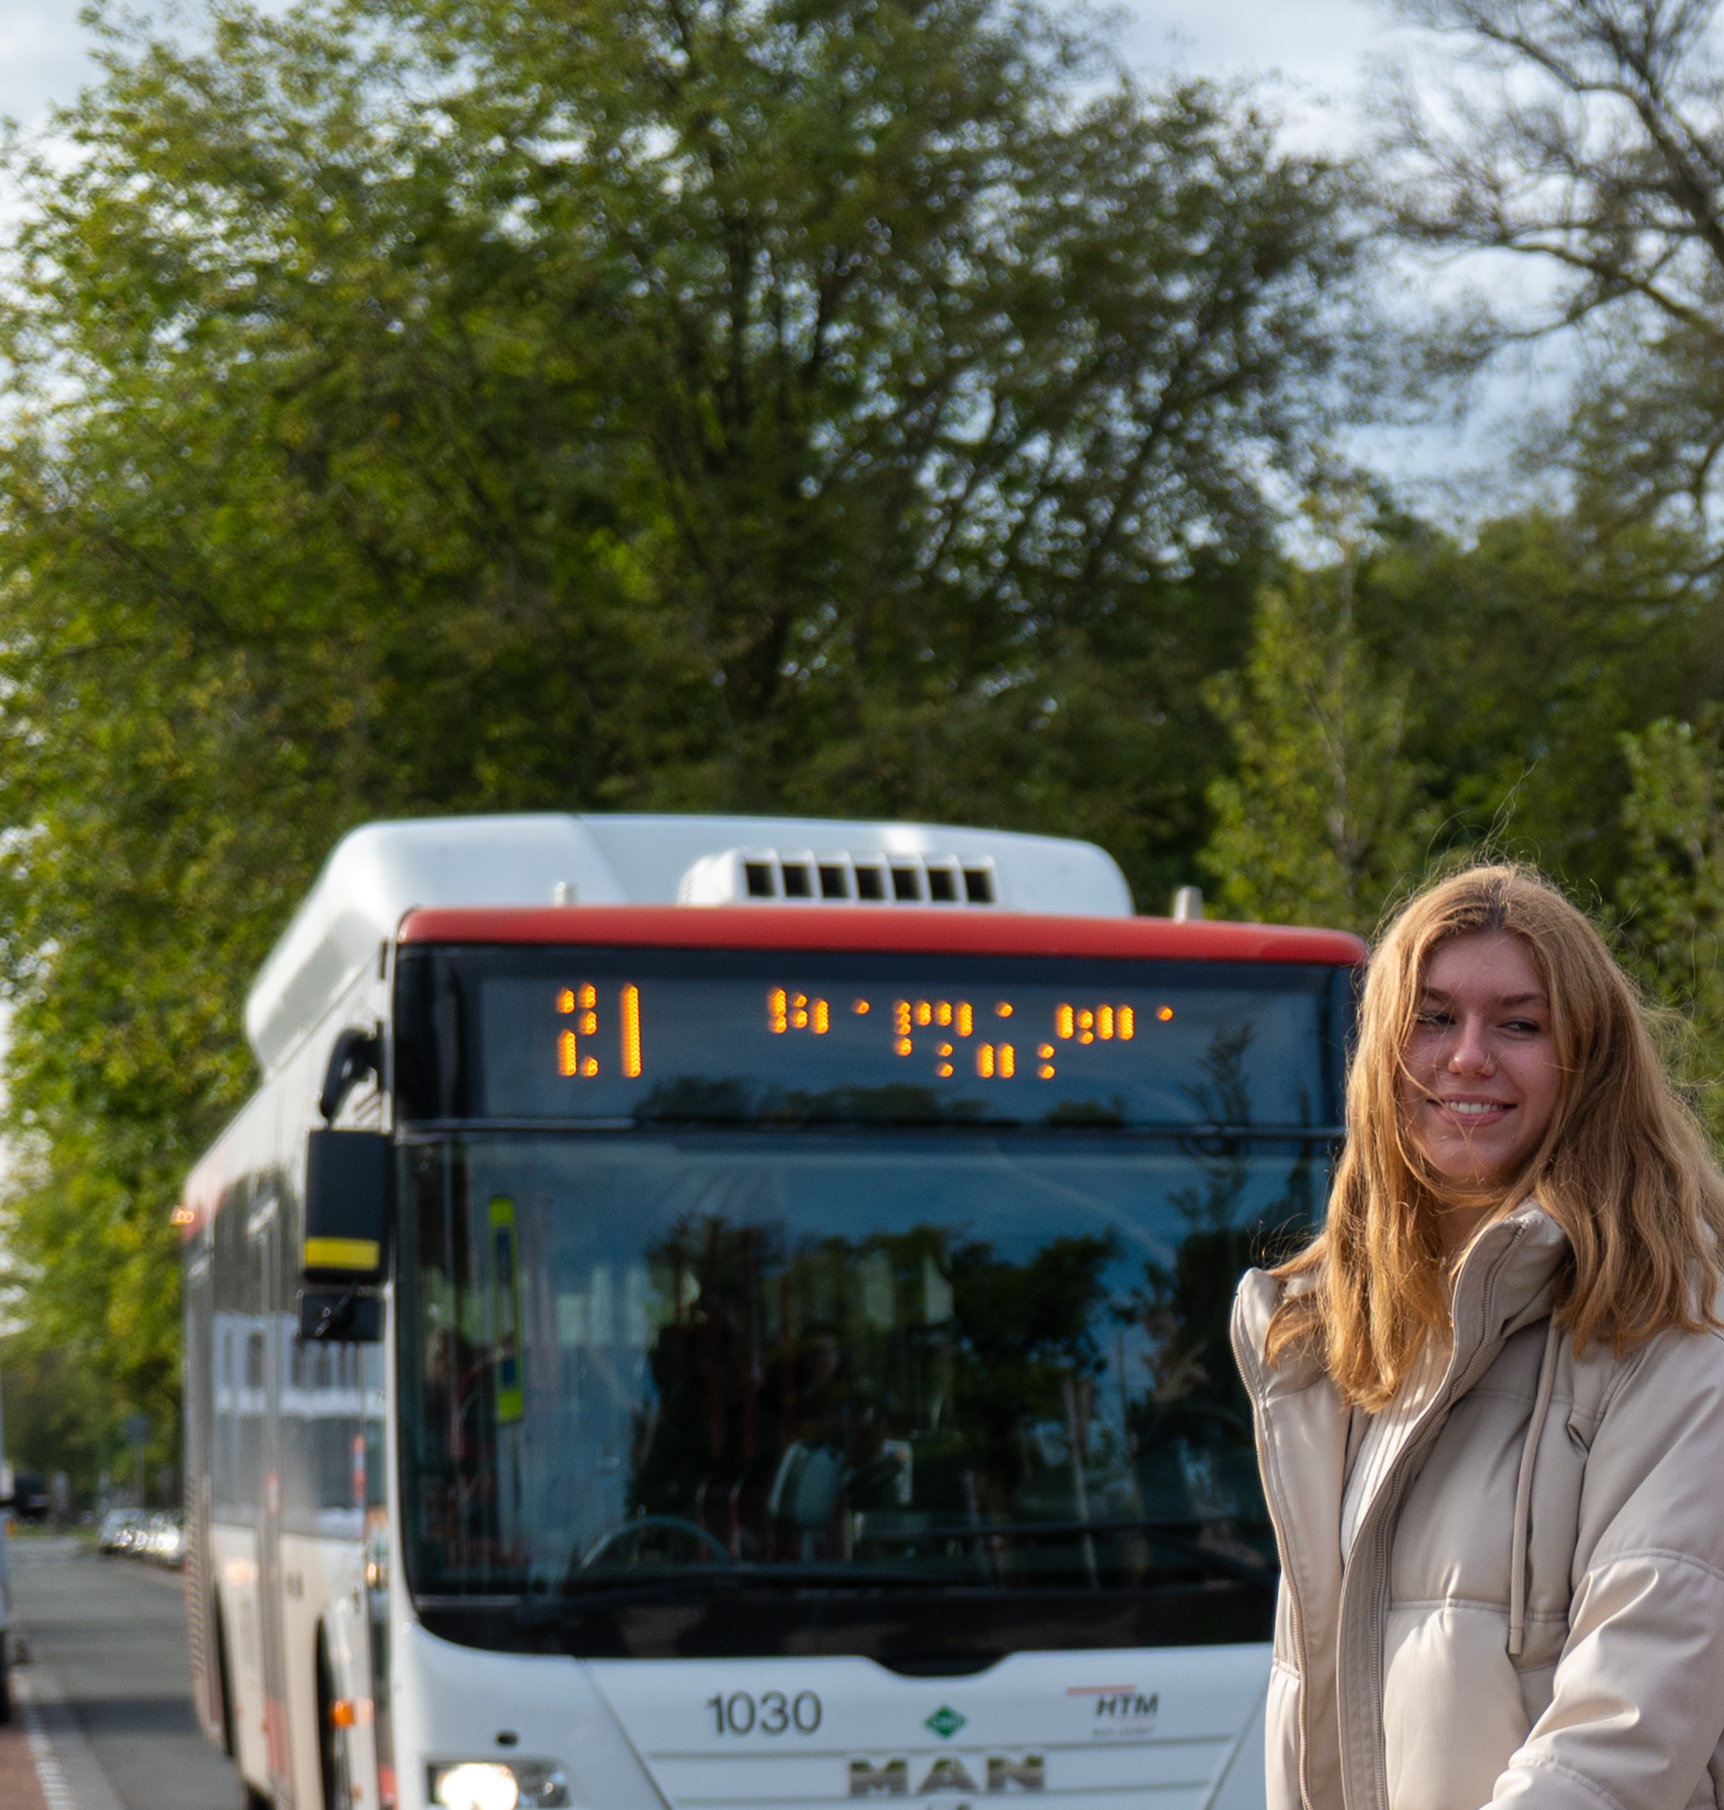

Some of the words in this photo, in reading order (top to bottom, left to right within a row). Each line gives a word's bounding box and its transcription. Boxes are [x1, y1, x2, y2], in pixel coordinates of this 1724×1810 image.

[706, 1691, 823, 1735] 1030
[1096, 1693, 1159, 1715] HTM
[848, 1755, 1044, 1796] MAN
